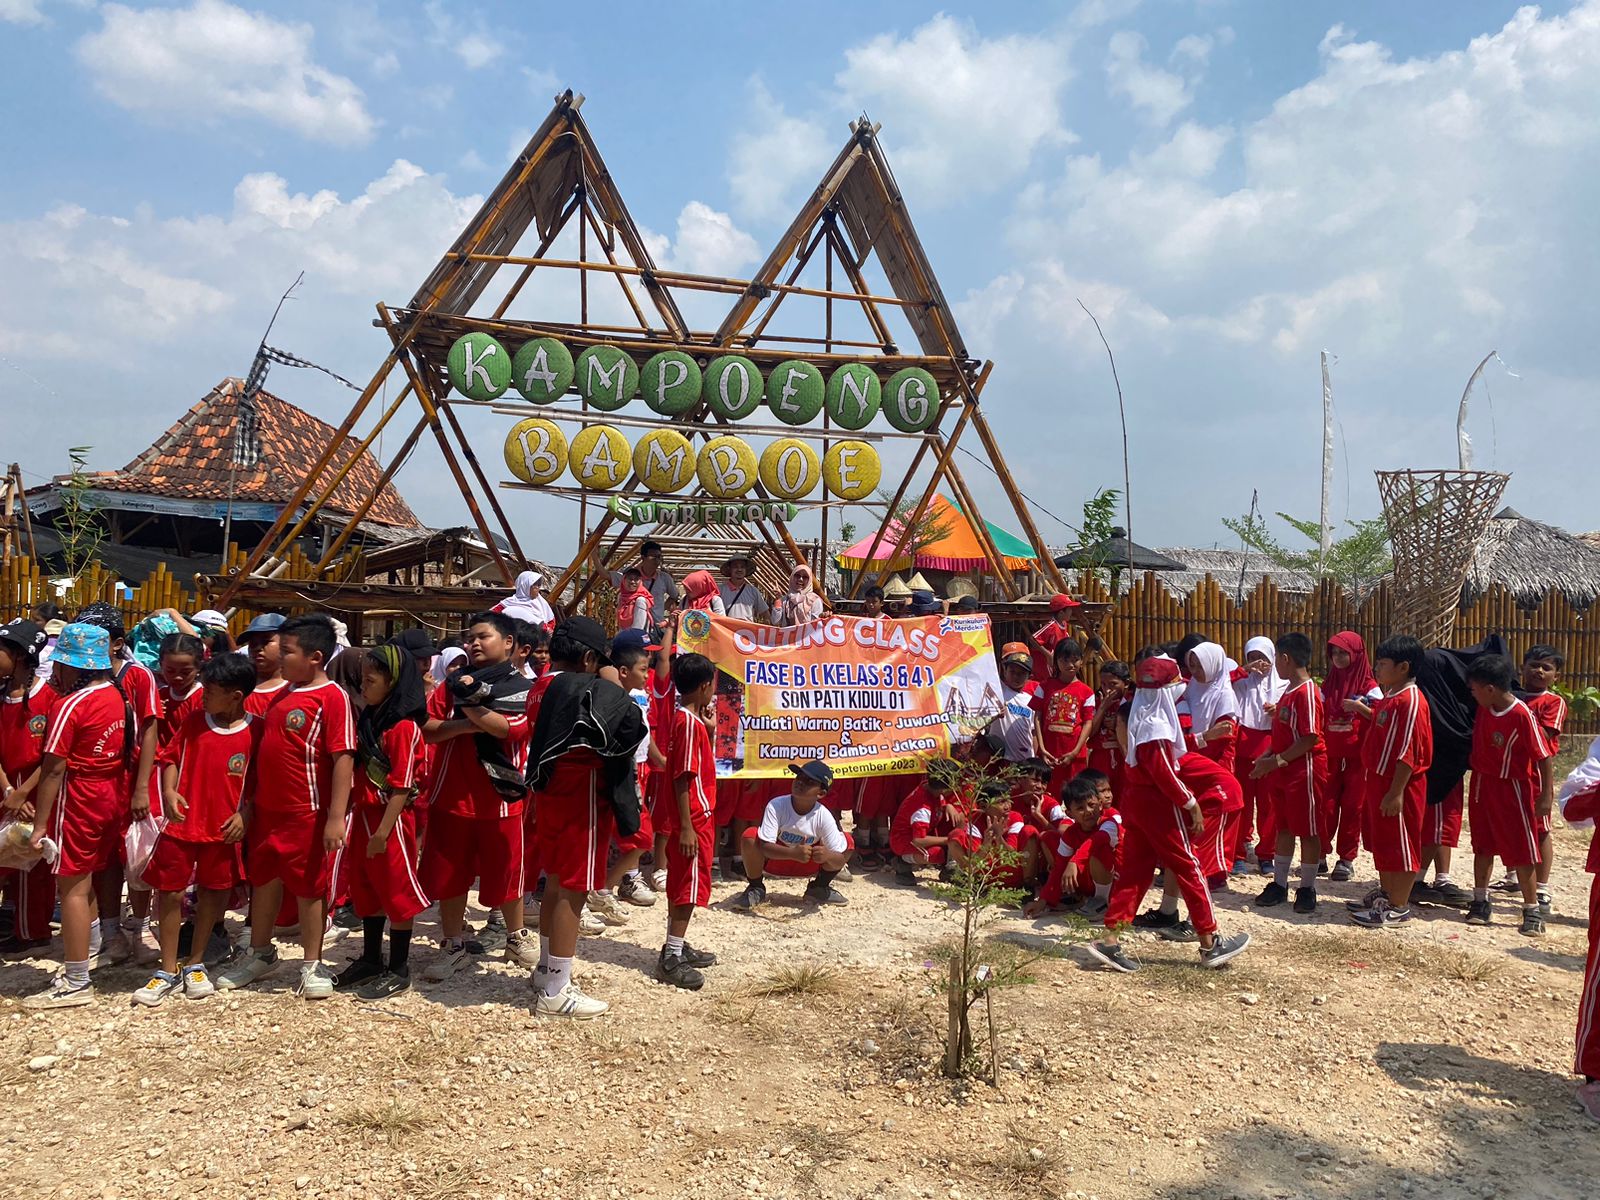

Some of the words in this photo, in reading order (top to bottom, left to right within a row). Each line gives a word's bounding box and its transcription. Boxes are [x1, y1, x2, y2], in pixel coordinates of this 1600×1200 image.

[464, 341, 928, 424] KAMPOENG
[518, 427, 862, 495] BAMBOE
[617, 497, 788, 525] SUMBERAN
[734, 618, 846, 652] OUTING
[854, 620, 940, 660] CLASS
[746, 661, 789, 686] FASE
[794, 666, 806, 687] B
[823, 664, 879, 686] KELAS
[883, 665, 893, 686] 3
[898, 666, 909, 687] &
[912, 667, 922, 687] 4
[781, 691, 810, 709] SDN
[814, 690, 844, 708] PATI
[849, 690, 886, 709] KIDUL
[889, 691, 904, 709] 01
[740, 715, 792, 731] Yuliati
[796, 716, 840, 731] Warno
[843, 717, 882, 731] Batik
[896, 712, 949, 729] Juwana
[759, 743, 825, 760] Kampung
[829, 744, 878, 758] Bambu
[892, 737, 935, 752] Jaken
[841, 731, 852, 745] &
[890, 760, 915, 771] 2023
